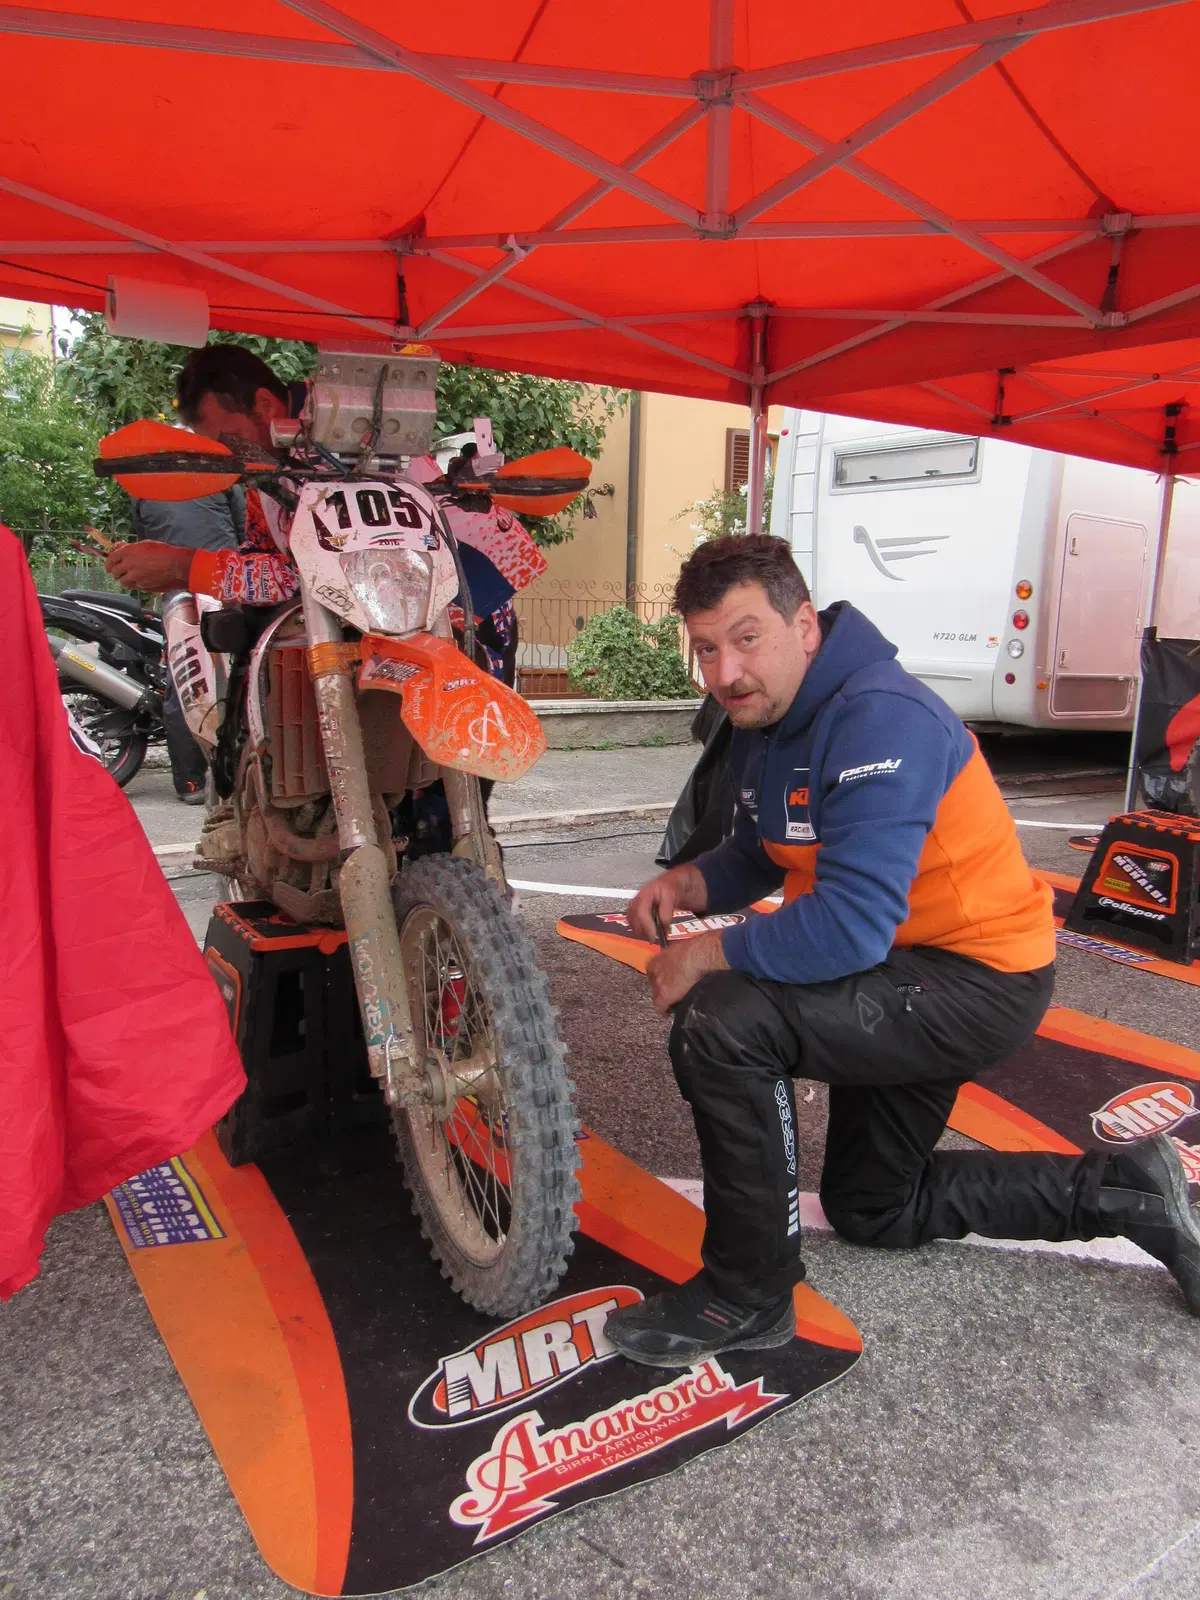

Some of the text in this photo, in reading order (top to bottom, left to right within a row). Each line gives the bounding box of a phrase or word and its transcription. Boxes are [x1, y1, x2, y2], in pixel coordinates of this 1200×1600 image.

[324, 489, 423, 529] 105
[933, 632, 977, 642] H720 GLM
[171, 645, 209, 713] 105
[1113, 854, 1168, 904] MONALDI
[671, 915, 734, 936] MRT
[1099, 896, 1167, 921] Polisport
[1094, 1088, 1198, 1140] MRT
[121, 1183, 144, 1219] CCESSORI
[139, 1221, 156, 1246] MOTO
[444, 1299, 619, 1417] MRT
[460, 1362, 728, 1518] Amarcord
[554, 1410, 693, 1476] BIRRA ARTIGIANALE
[600, 1434, 665, 1468] ITALIANA
